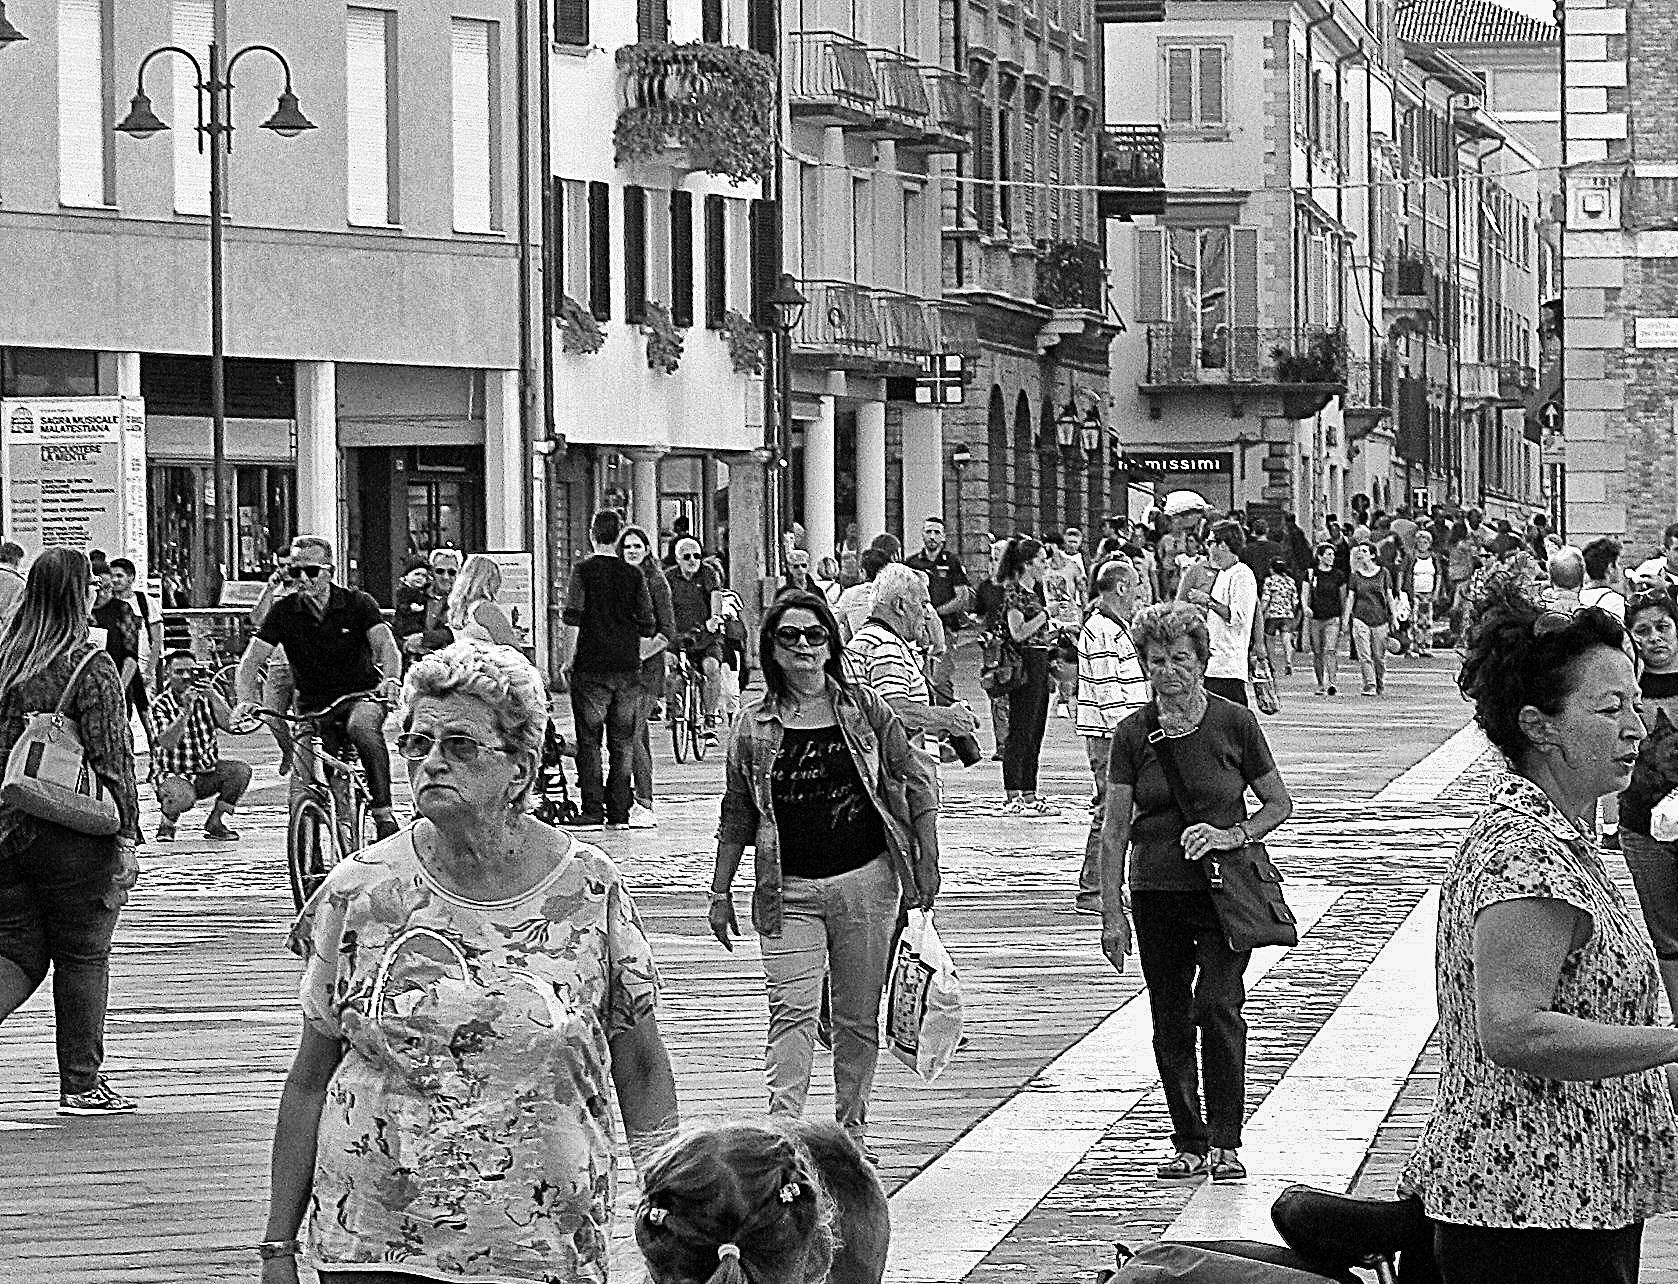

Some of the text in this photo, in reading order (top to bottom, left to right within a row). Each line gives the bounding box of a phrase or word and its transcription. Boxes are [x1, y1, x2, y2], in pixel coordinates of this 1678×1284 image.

[40, 416, 71, 425] SAGRA
[72, 415, 119, 424] MUSICALE
[40, 424, 110, 433] MALATESTIANA
